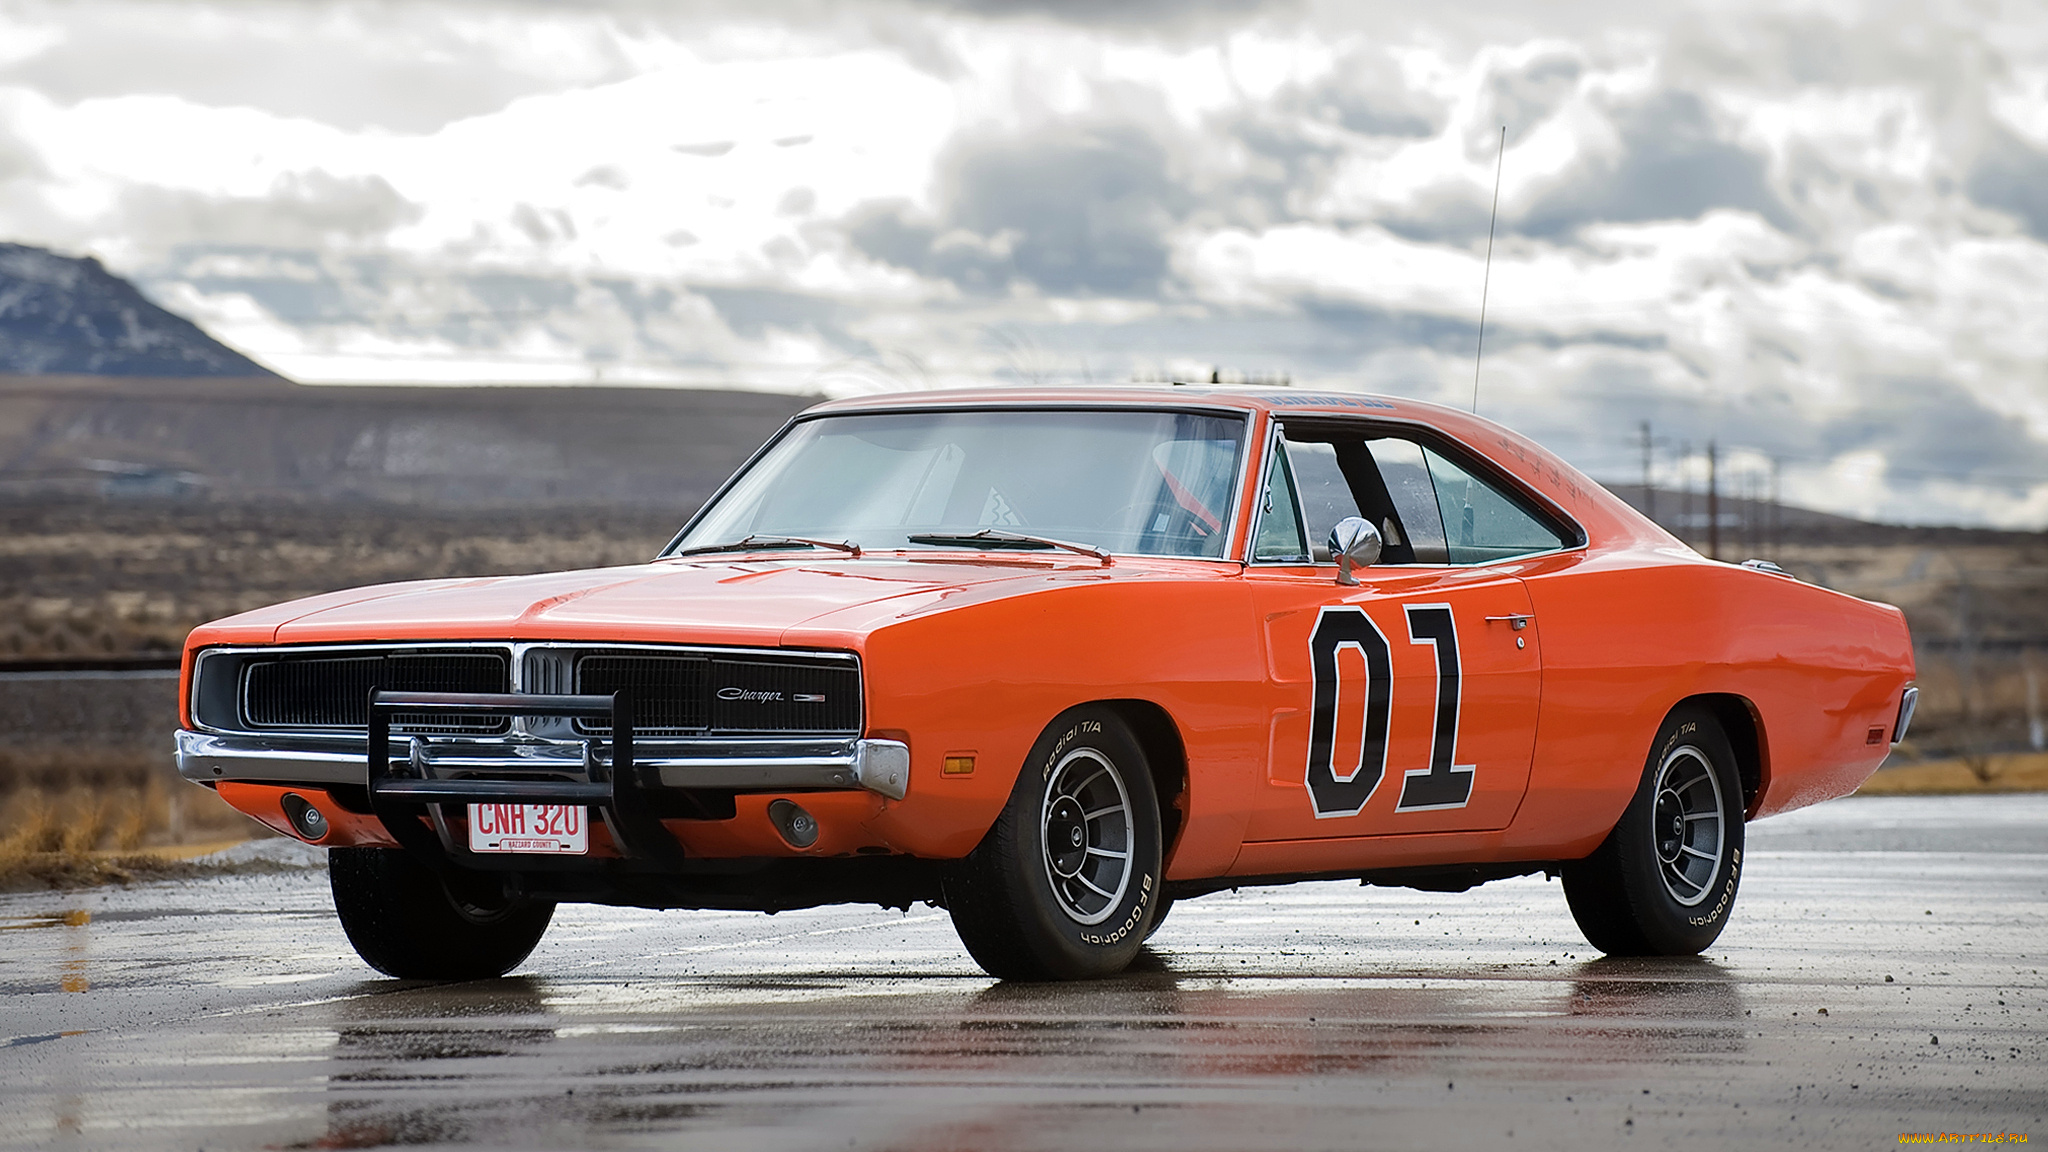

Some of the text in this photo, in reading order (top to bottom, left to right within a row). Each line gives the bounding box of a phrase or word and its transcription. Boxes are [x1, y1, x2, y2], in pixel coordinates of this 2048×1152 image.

[716, 687, 784, 705] Charger
[1304, 603, 1476, 820] 01
[1681, 721, 1697, 734] T/A
[1042, 720, 1102, 782] Radial T/A
[478, 803, 579, 835] CNH 320
[533, 841, 552, 849] COUNTY
